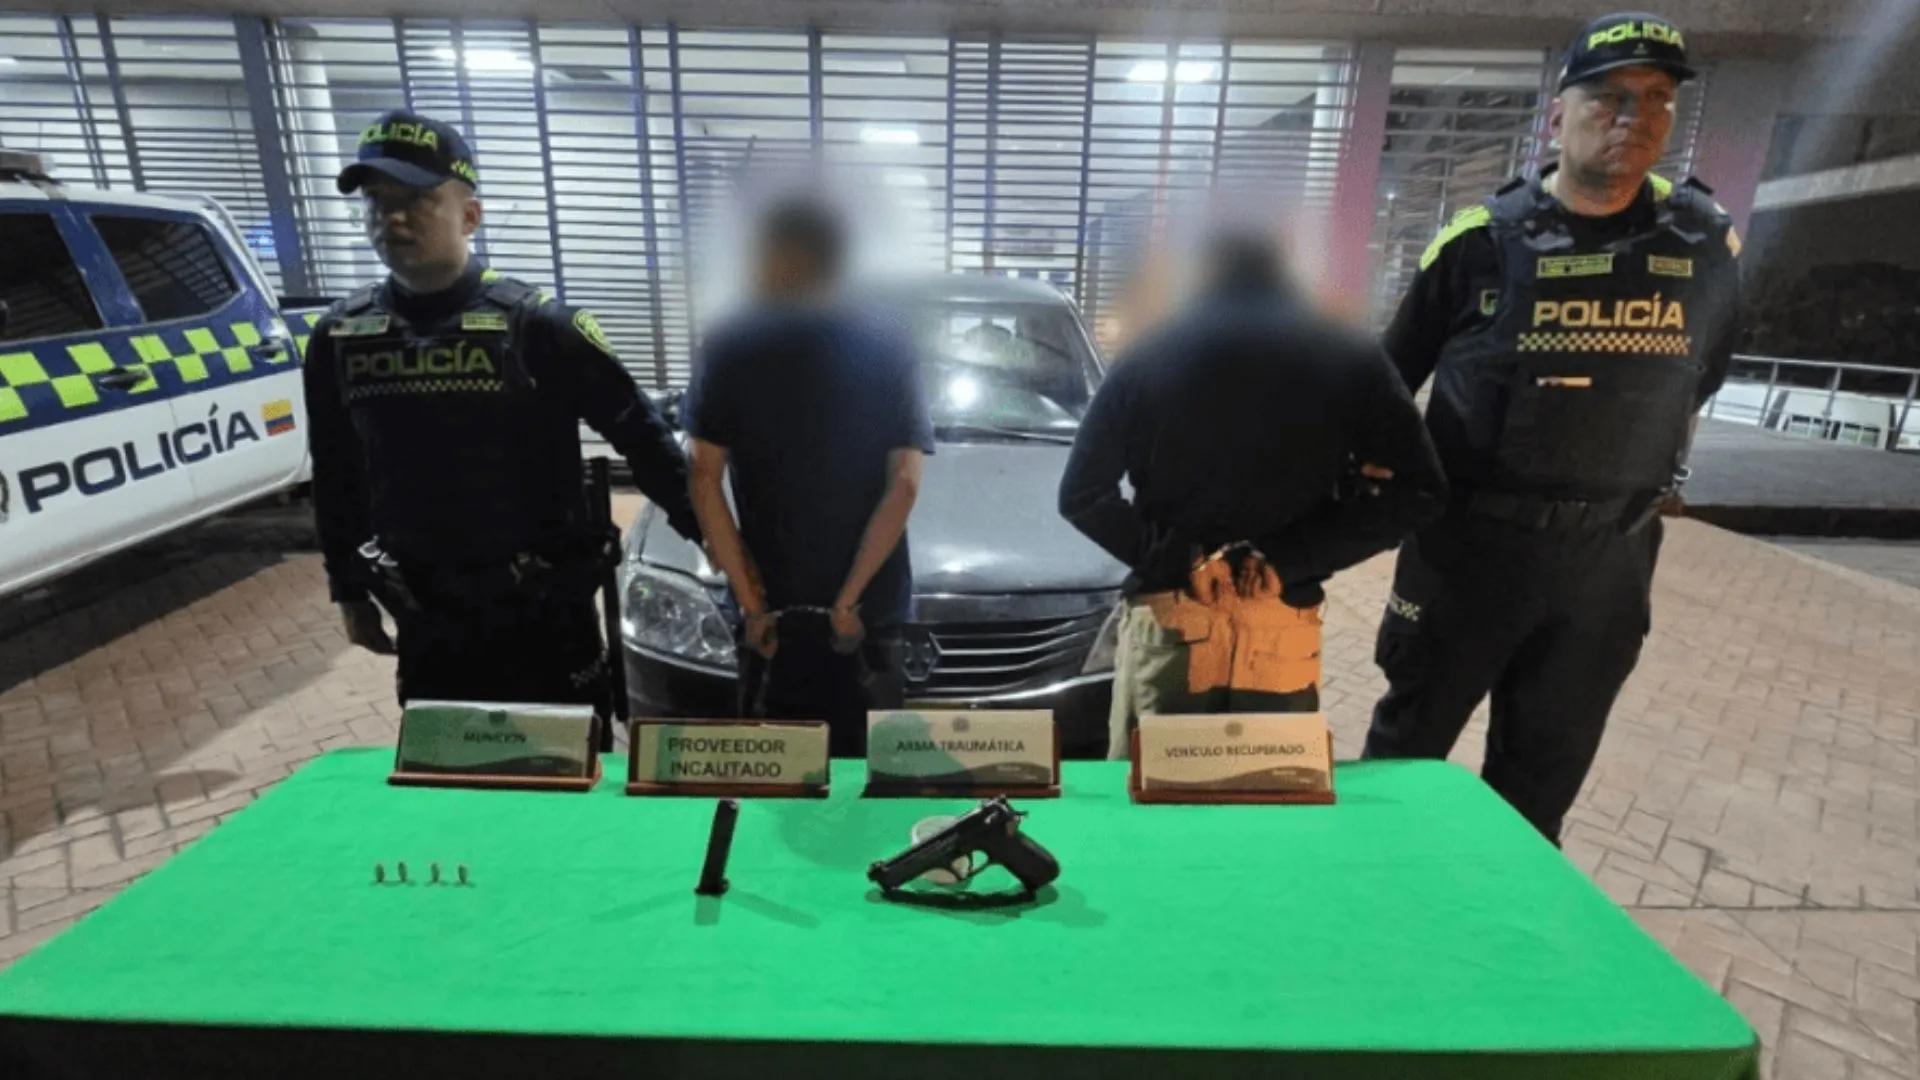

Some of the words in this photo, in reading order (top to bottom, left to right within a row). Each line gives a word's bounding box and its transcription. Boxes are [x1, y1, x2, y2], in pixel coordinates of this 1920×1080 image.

[1533, 291, 1684, 329] POLICÍA
[346, 341, 495, 380] POLICÍA
[18, 403, 260, 513] POLICÍA
[668, 737, 786, 754] PROVEEDOR
[897, 739, 936, 751] ARMA
[940, 737, 1025, 752] TRAUMÁTICA
[1226, 743, 1305, 756] RECUPERADO
[670, 760, 782, 778] INCAUTADO
